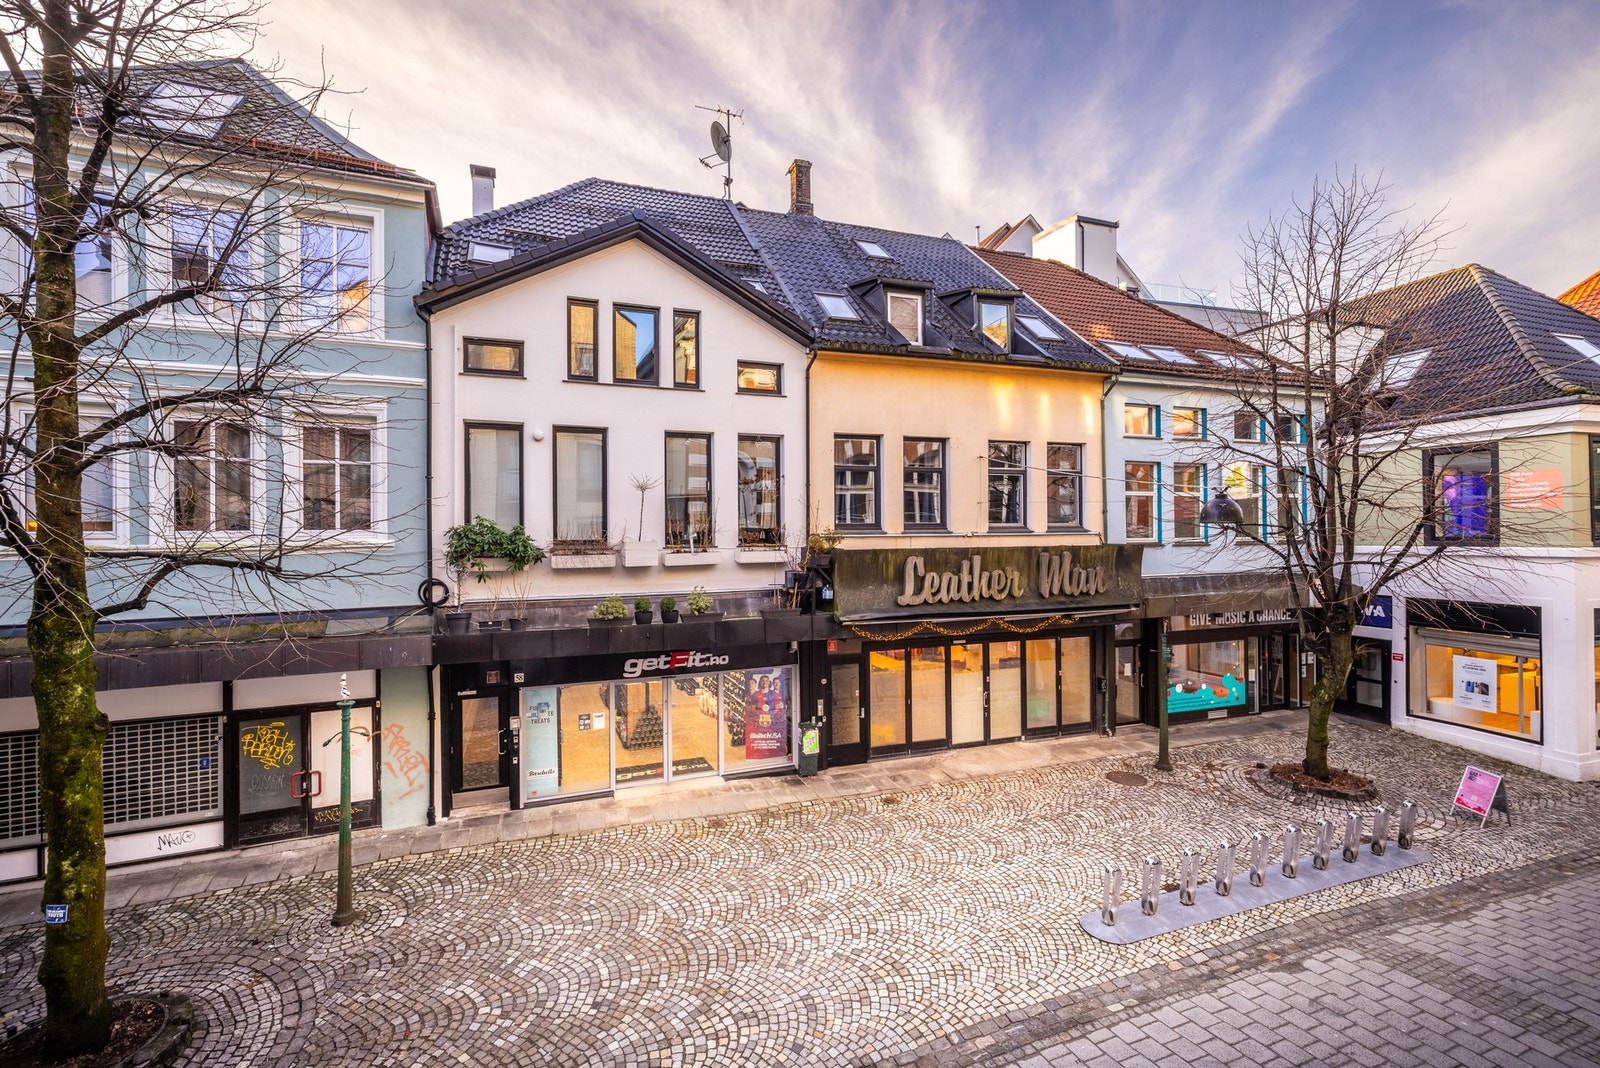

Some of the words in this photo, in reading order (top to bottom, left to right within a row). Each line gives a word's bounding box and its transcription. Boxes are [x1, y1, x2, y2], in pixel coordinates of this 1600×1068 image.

[897, 555, 1024, 607] Leather
[1039, 551, 1107, 599] Man
[1189, 613, 1211, 627] GIVE
[1216, 611, 1246, 625] MUSIC
[1248, 610, 1255, 623] A
[1257, 608, 1291, 622] CHANCE
